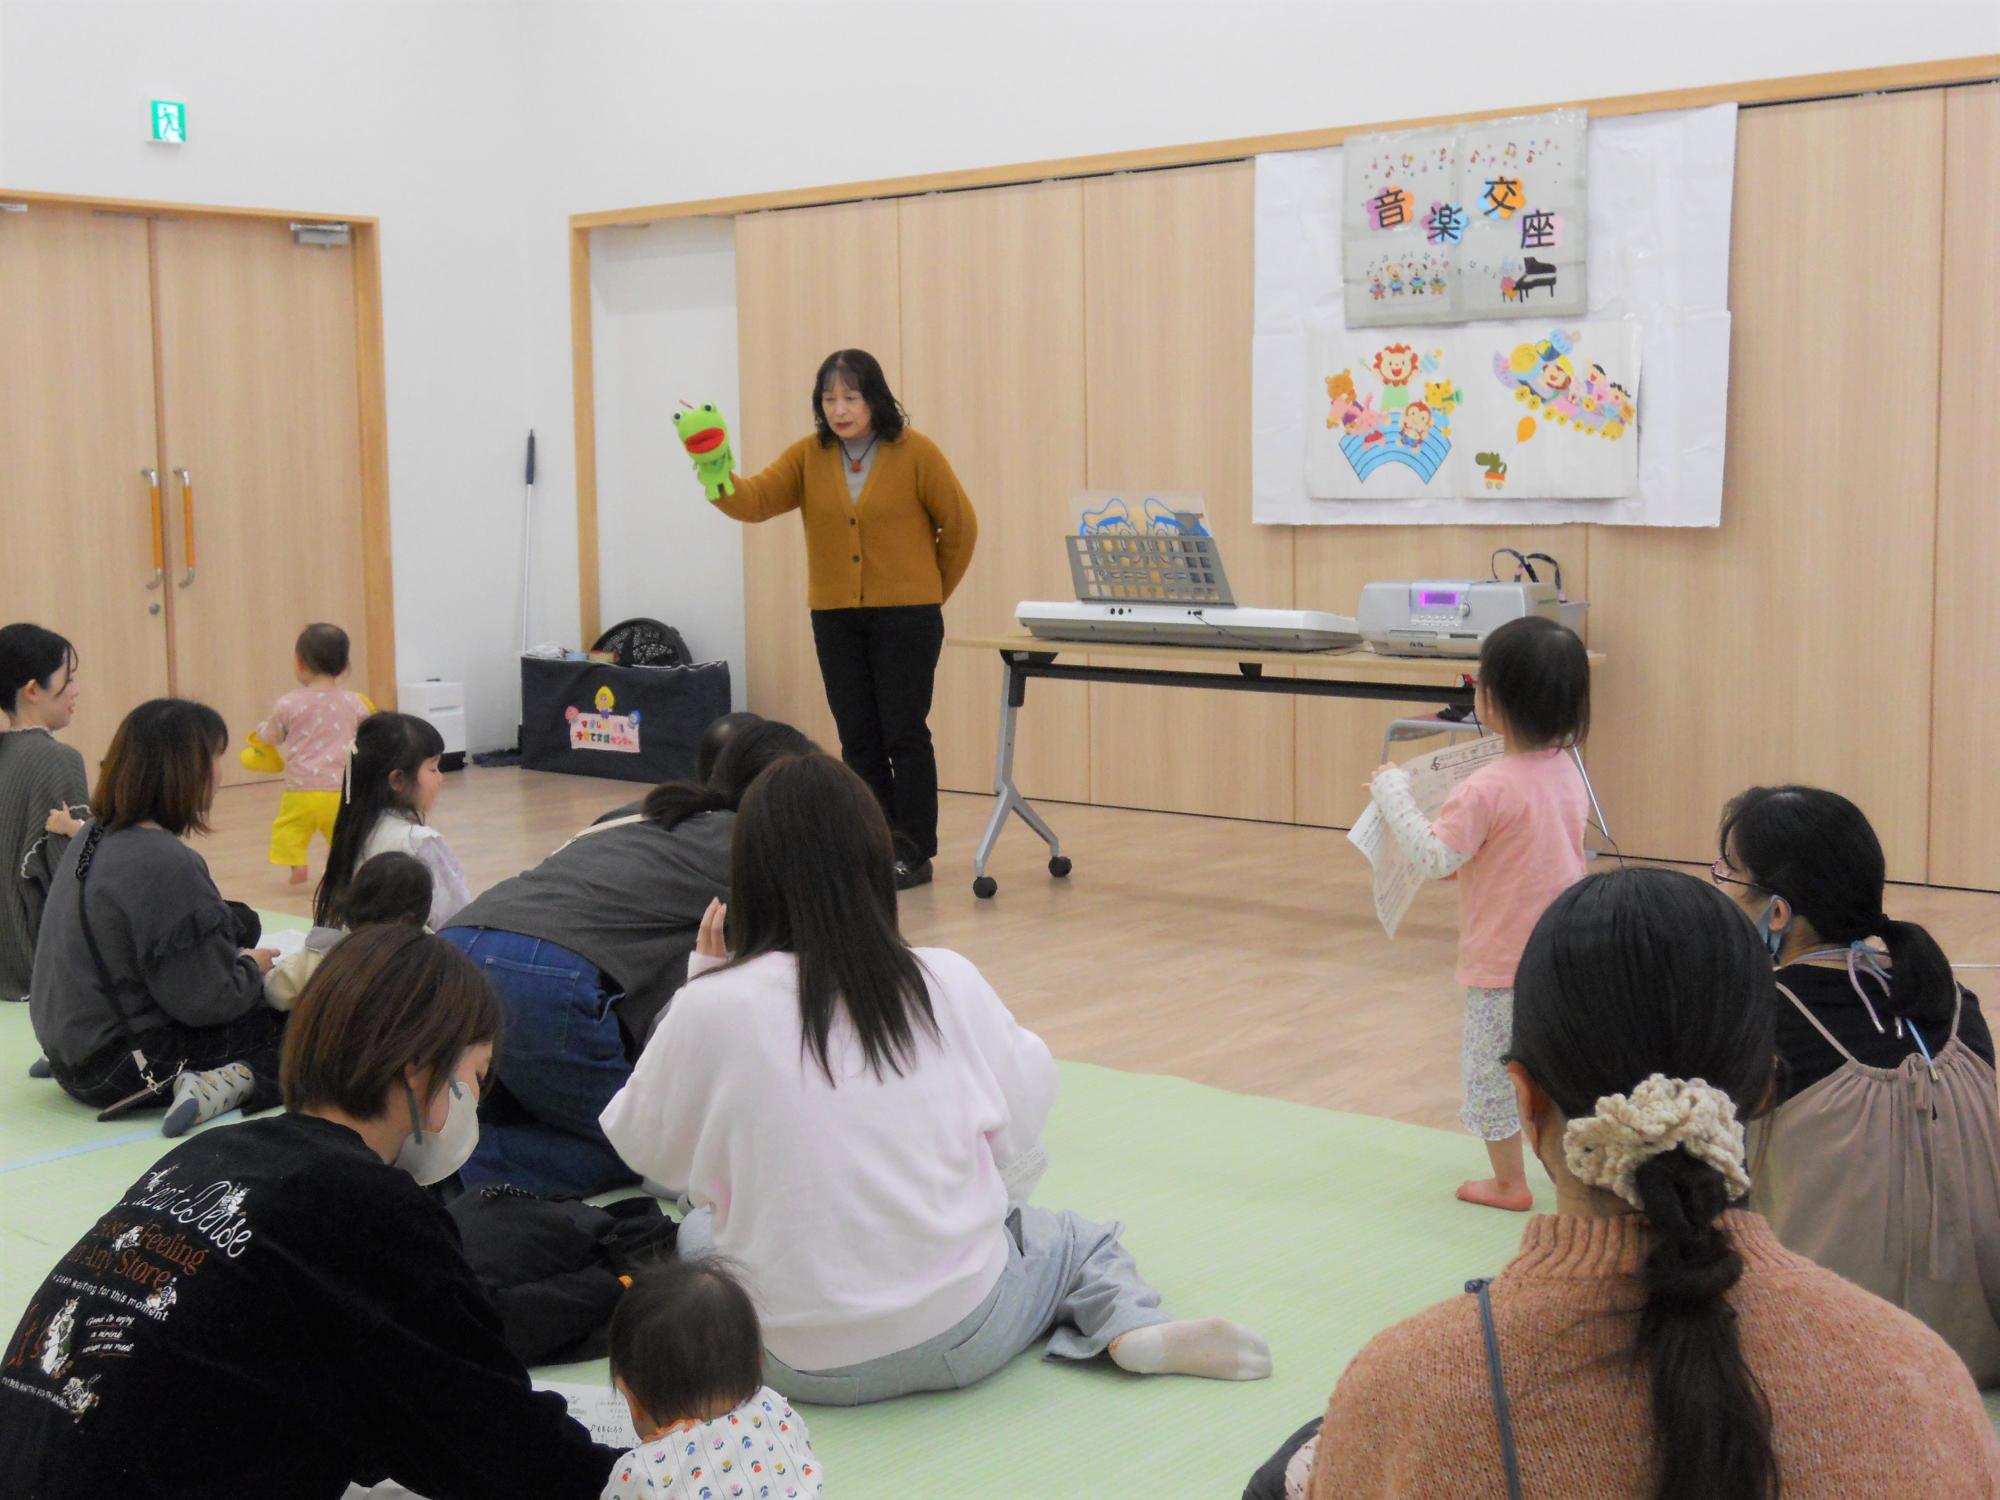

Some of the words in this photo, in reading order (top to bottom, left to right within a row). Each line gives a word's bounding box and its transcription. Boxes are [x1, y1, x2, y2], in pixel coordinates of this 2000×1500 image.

[1374, 176, 1556, 249] 音楽交座
[114, 1248, 172, 1288] Store
[140, 1222, 209, 1276] Feeling
[99, 1284, 109, 1296] for
[110, 1290, 128, 1303] this
[128, 1297, 170, 1321] moment
